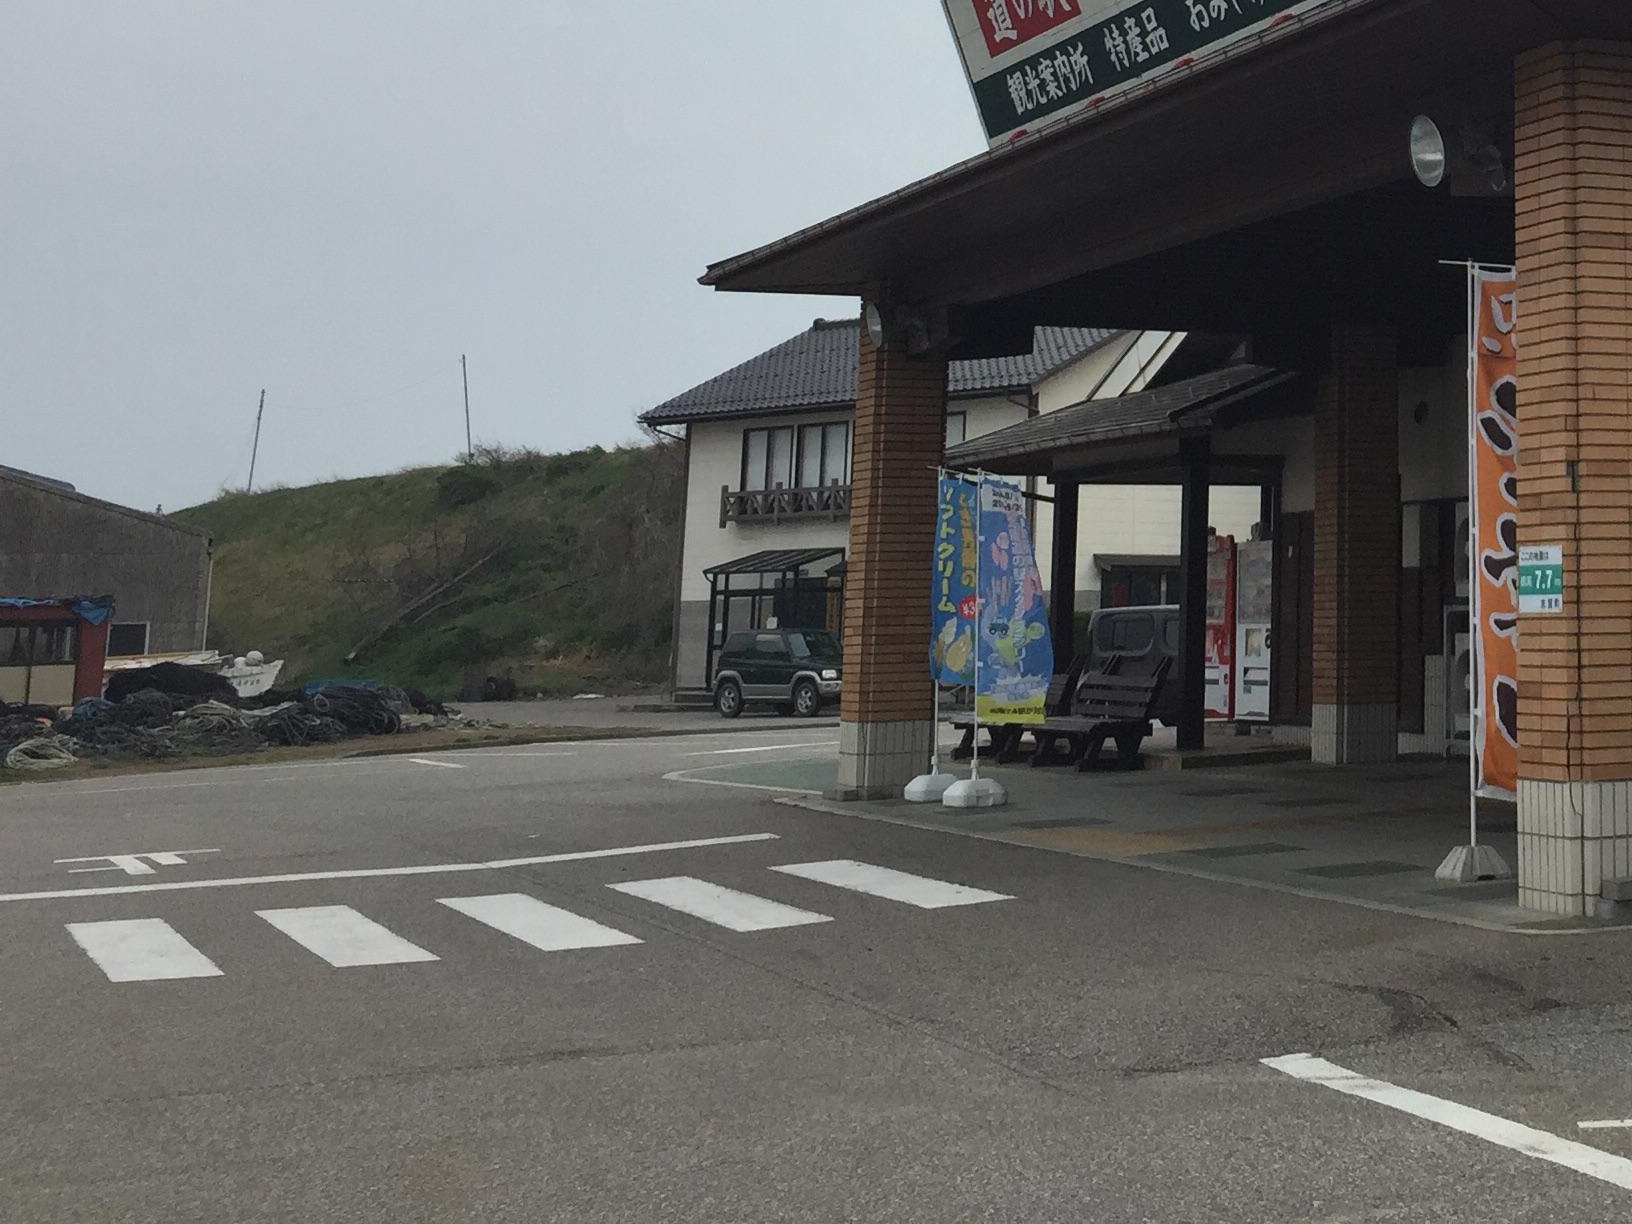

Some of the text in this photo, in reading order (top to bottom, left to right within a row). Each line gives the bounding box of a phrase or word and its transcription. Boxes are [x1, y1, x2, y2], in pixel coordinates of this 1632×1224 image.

[1006, 41, 1095, 116] 観光案内所
[1103, 7, 1170, 72] 特産品
[936, 484, 957, 613] ソフトクリーム
[1534, 570, 1553, 589] 7.7
